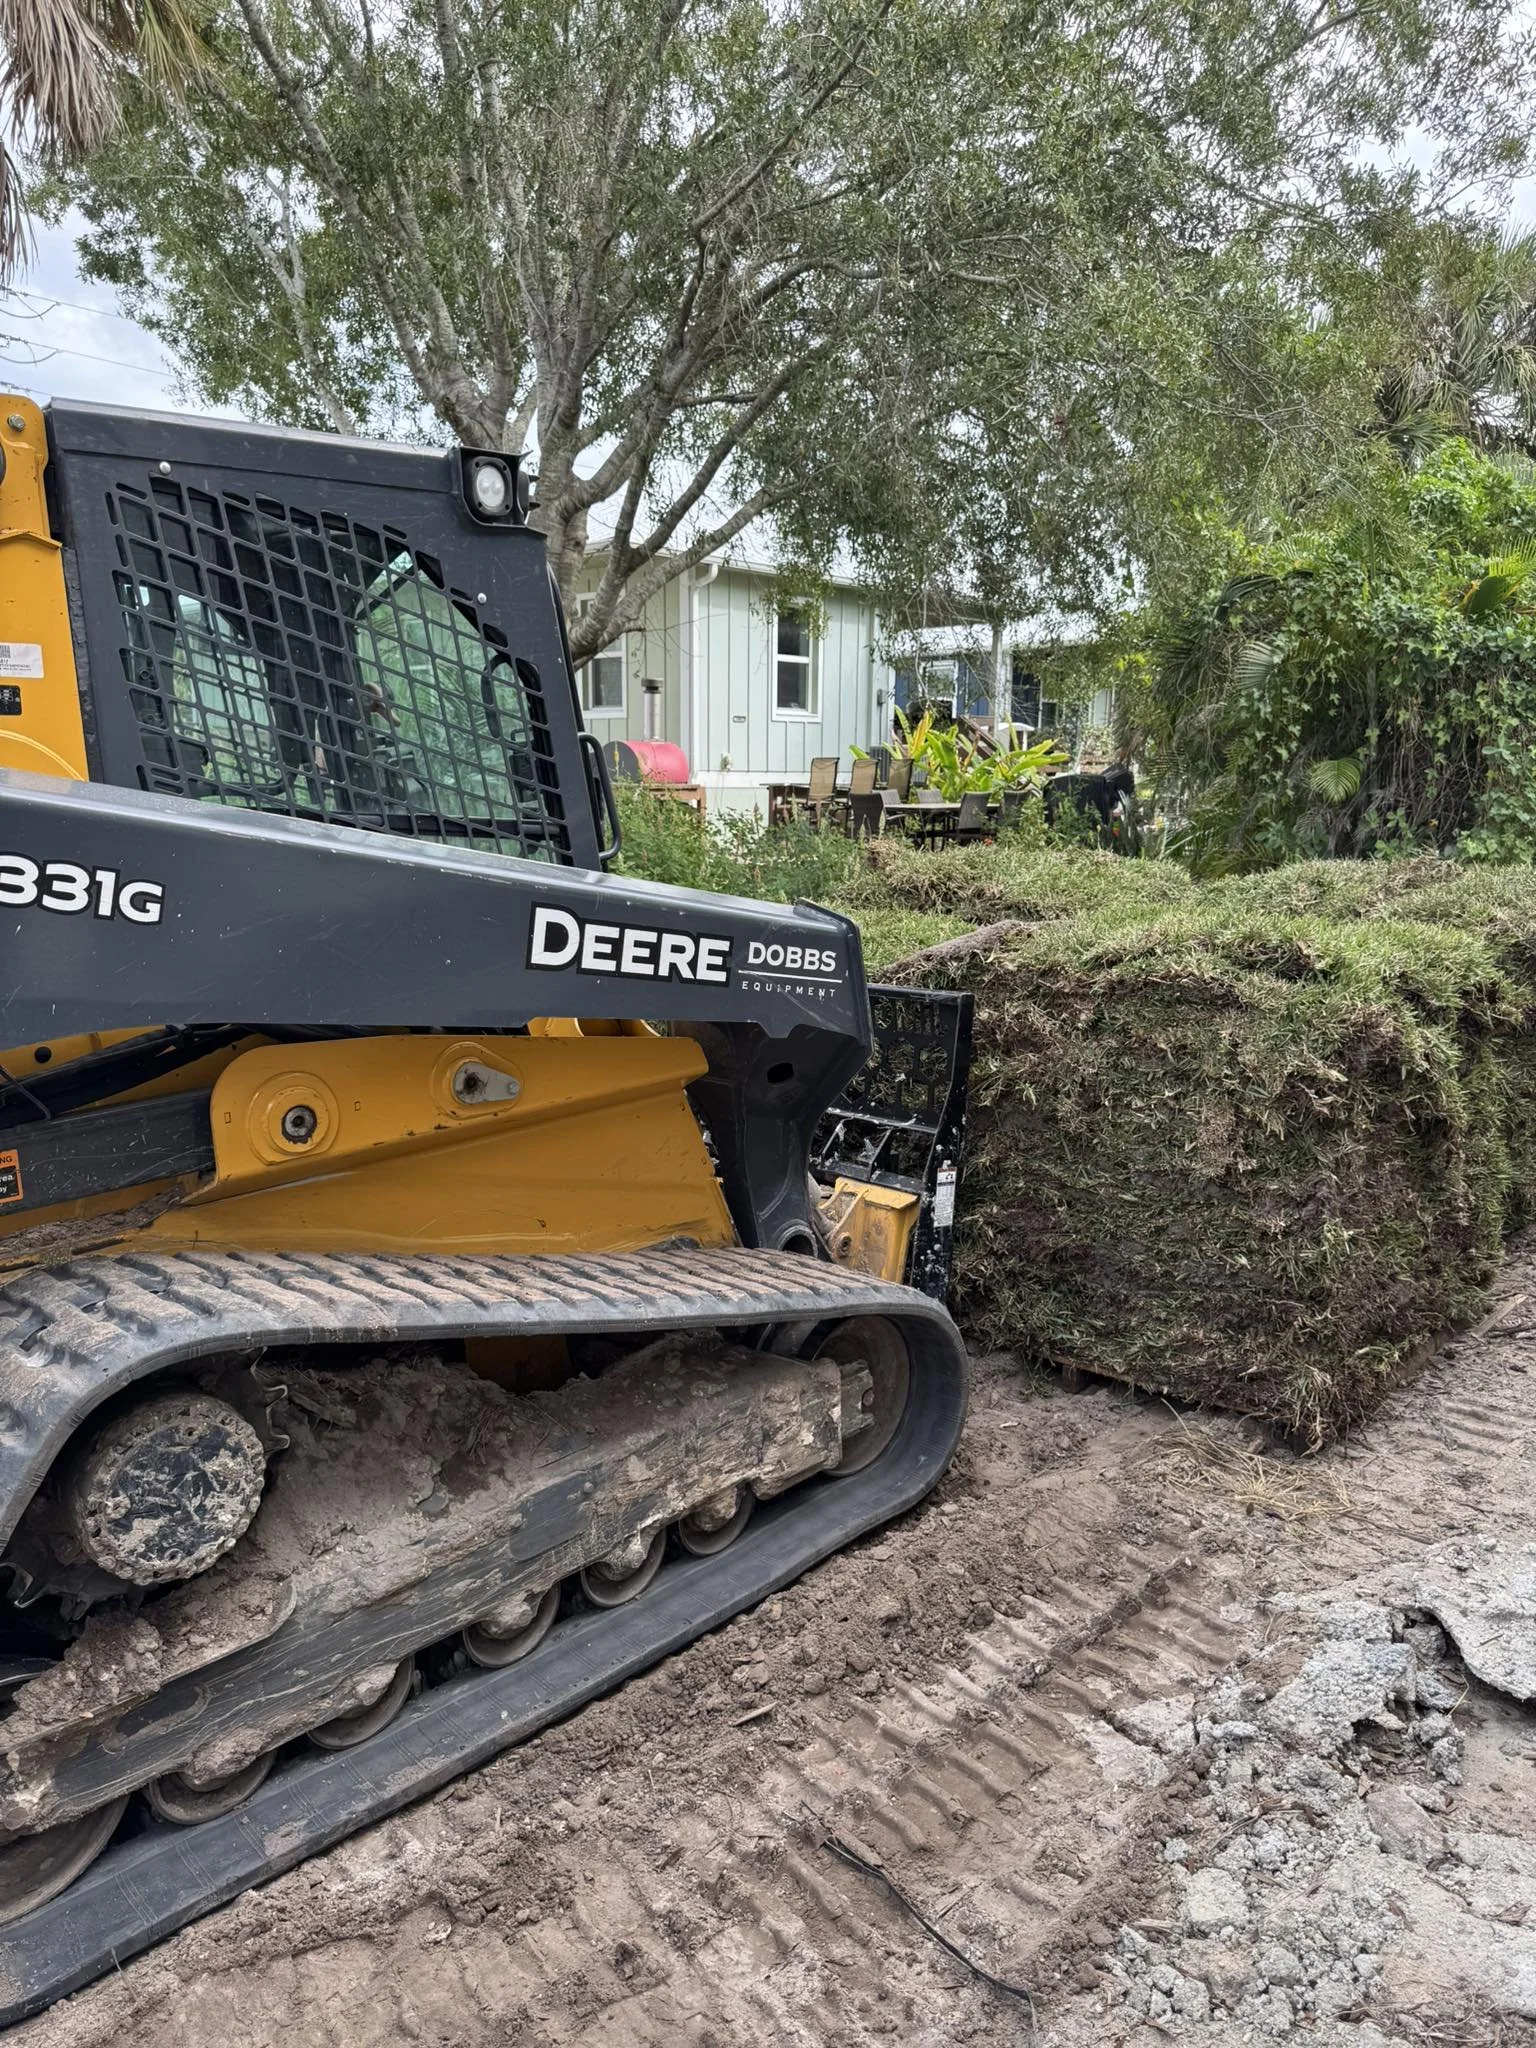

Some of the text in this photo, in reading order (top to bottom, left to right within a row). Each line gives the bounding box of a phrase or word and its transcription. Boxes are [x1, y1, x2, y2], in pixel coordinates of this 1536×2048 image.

[0, 854, 164, 923] 331G
[530, 906, 731, 982] DEERE
[747, 941, 837, 972] DOBBS
[742, 981, 836, 997] EQUIPMENT
